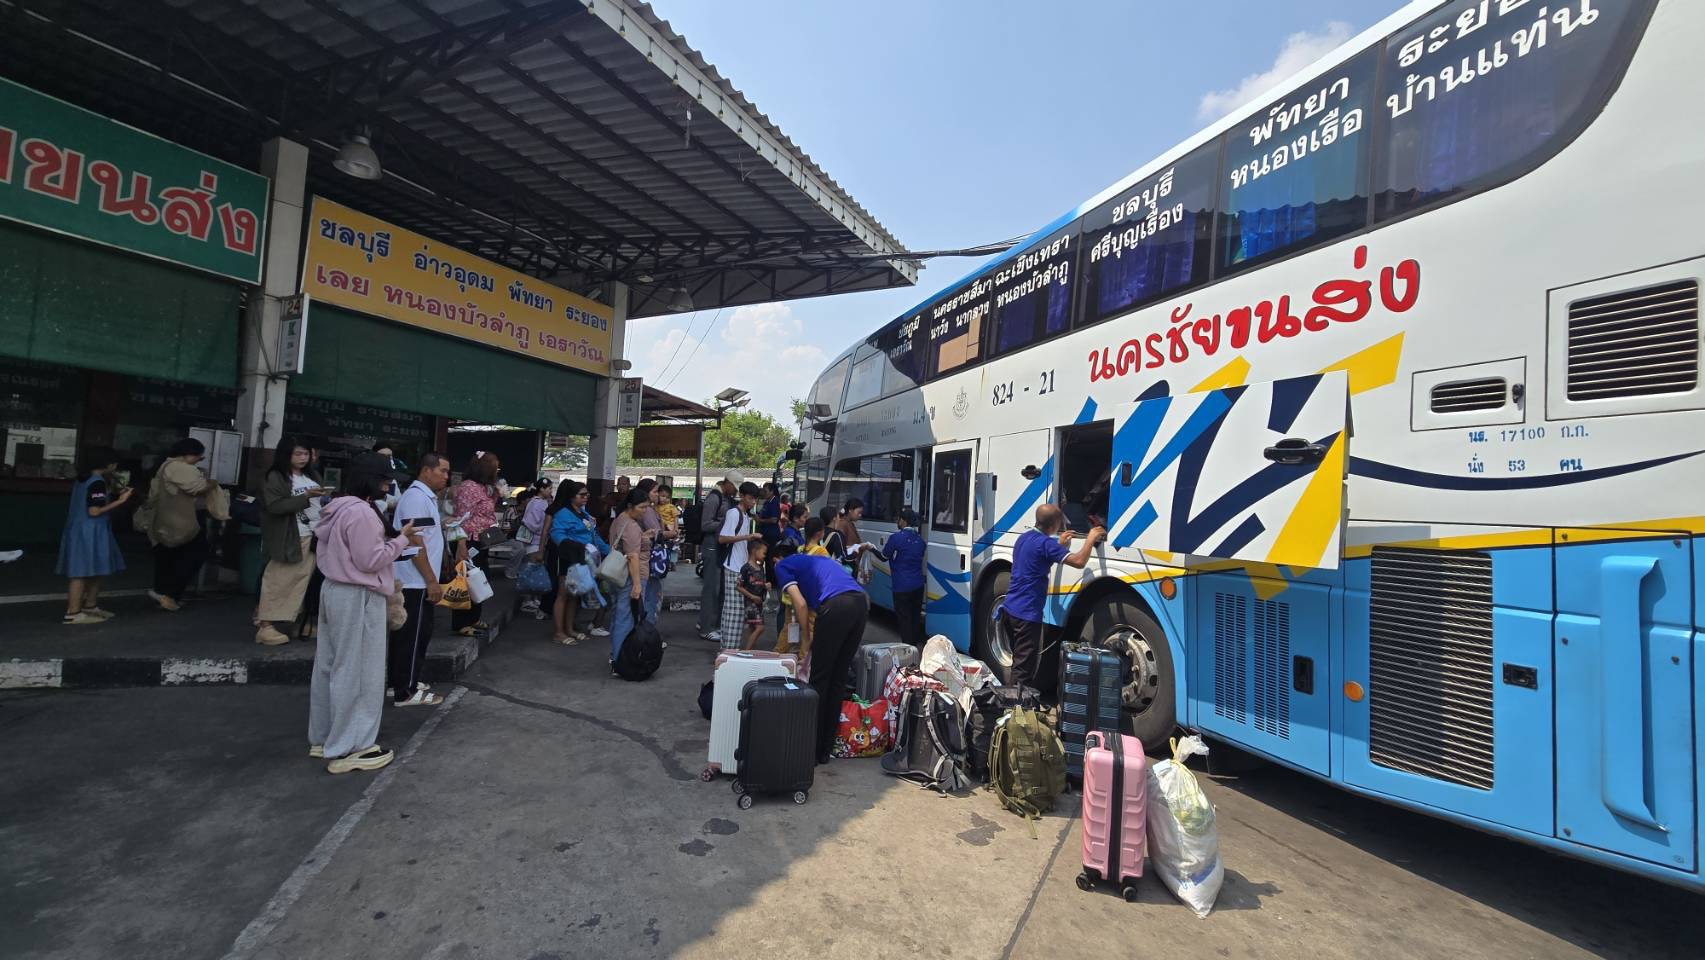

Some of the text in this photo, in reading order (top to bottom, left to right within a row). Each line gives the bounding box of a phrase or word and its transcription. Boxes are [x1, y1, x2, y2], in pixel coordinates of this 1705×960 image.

[0, 125, 259, 256] ขนส่ง
[930, 318, 949, 341] นาวัง
[955, 301, 990, 328] นากลาง
[997, 261, 1069, 308] หนองบัวลำภู
[1091, 203, 1184, 263] ศรีบุญเรือง
[1231, 107, 1363, 189] หนองเรือ
[1386, 0, 1600, 119] บ้านแท่น
[933, 279, 992, 319] นครราชสีมา
[995, 234, 1070, 286] ฉะเชิงเทรา
[1112, 167, 1175, 223] ชลบุรี
[1249, 77, 1350, 146] พัทยา
[1398, 0, 1532, 67] ระย
[316, 265, 605, 363] เลย หนองบัวลำภู เอราวัณ
[320, 218, 608, 332] ชลบุรี อ่าวอุดม พัทยา ระยอง
[1088, 245, 1420, 383] นครชัยขนส่ง
[624, 381, 636, 391] 25
[992, 380, 1014, 407] 824
[1039, 369, 1055, 396] 21
[1501, 427, 1545, 442] 17100
[1561, 425, 1589, 438] ก.ก.
[1467, 453, 1583, 473] นั่ง 53 คน
